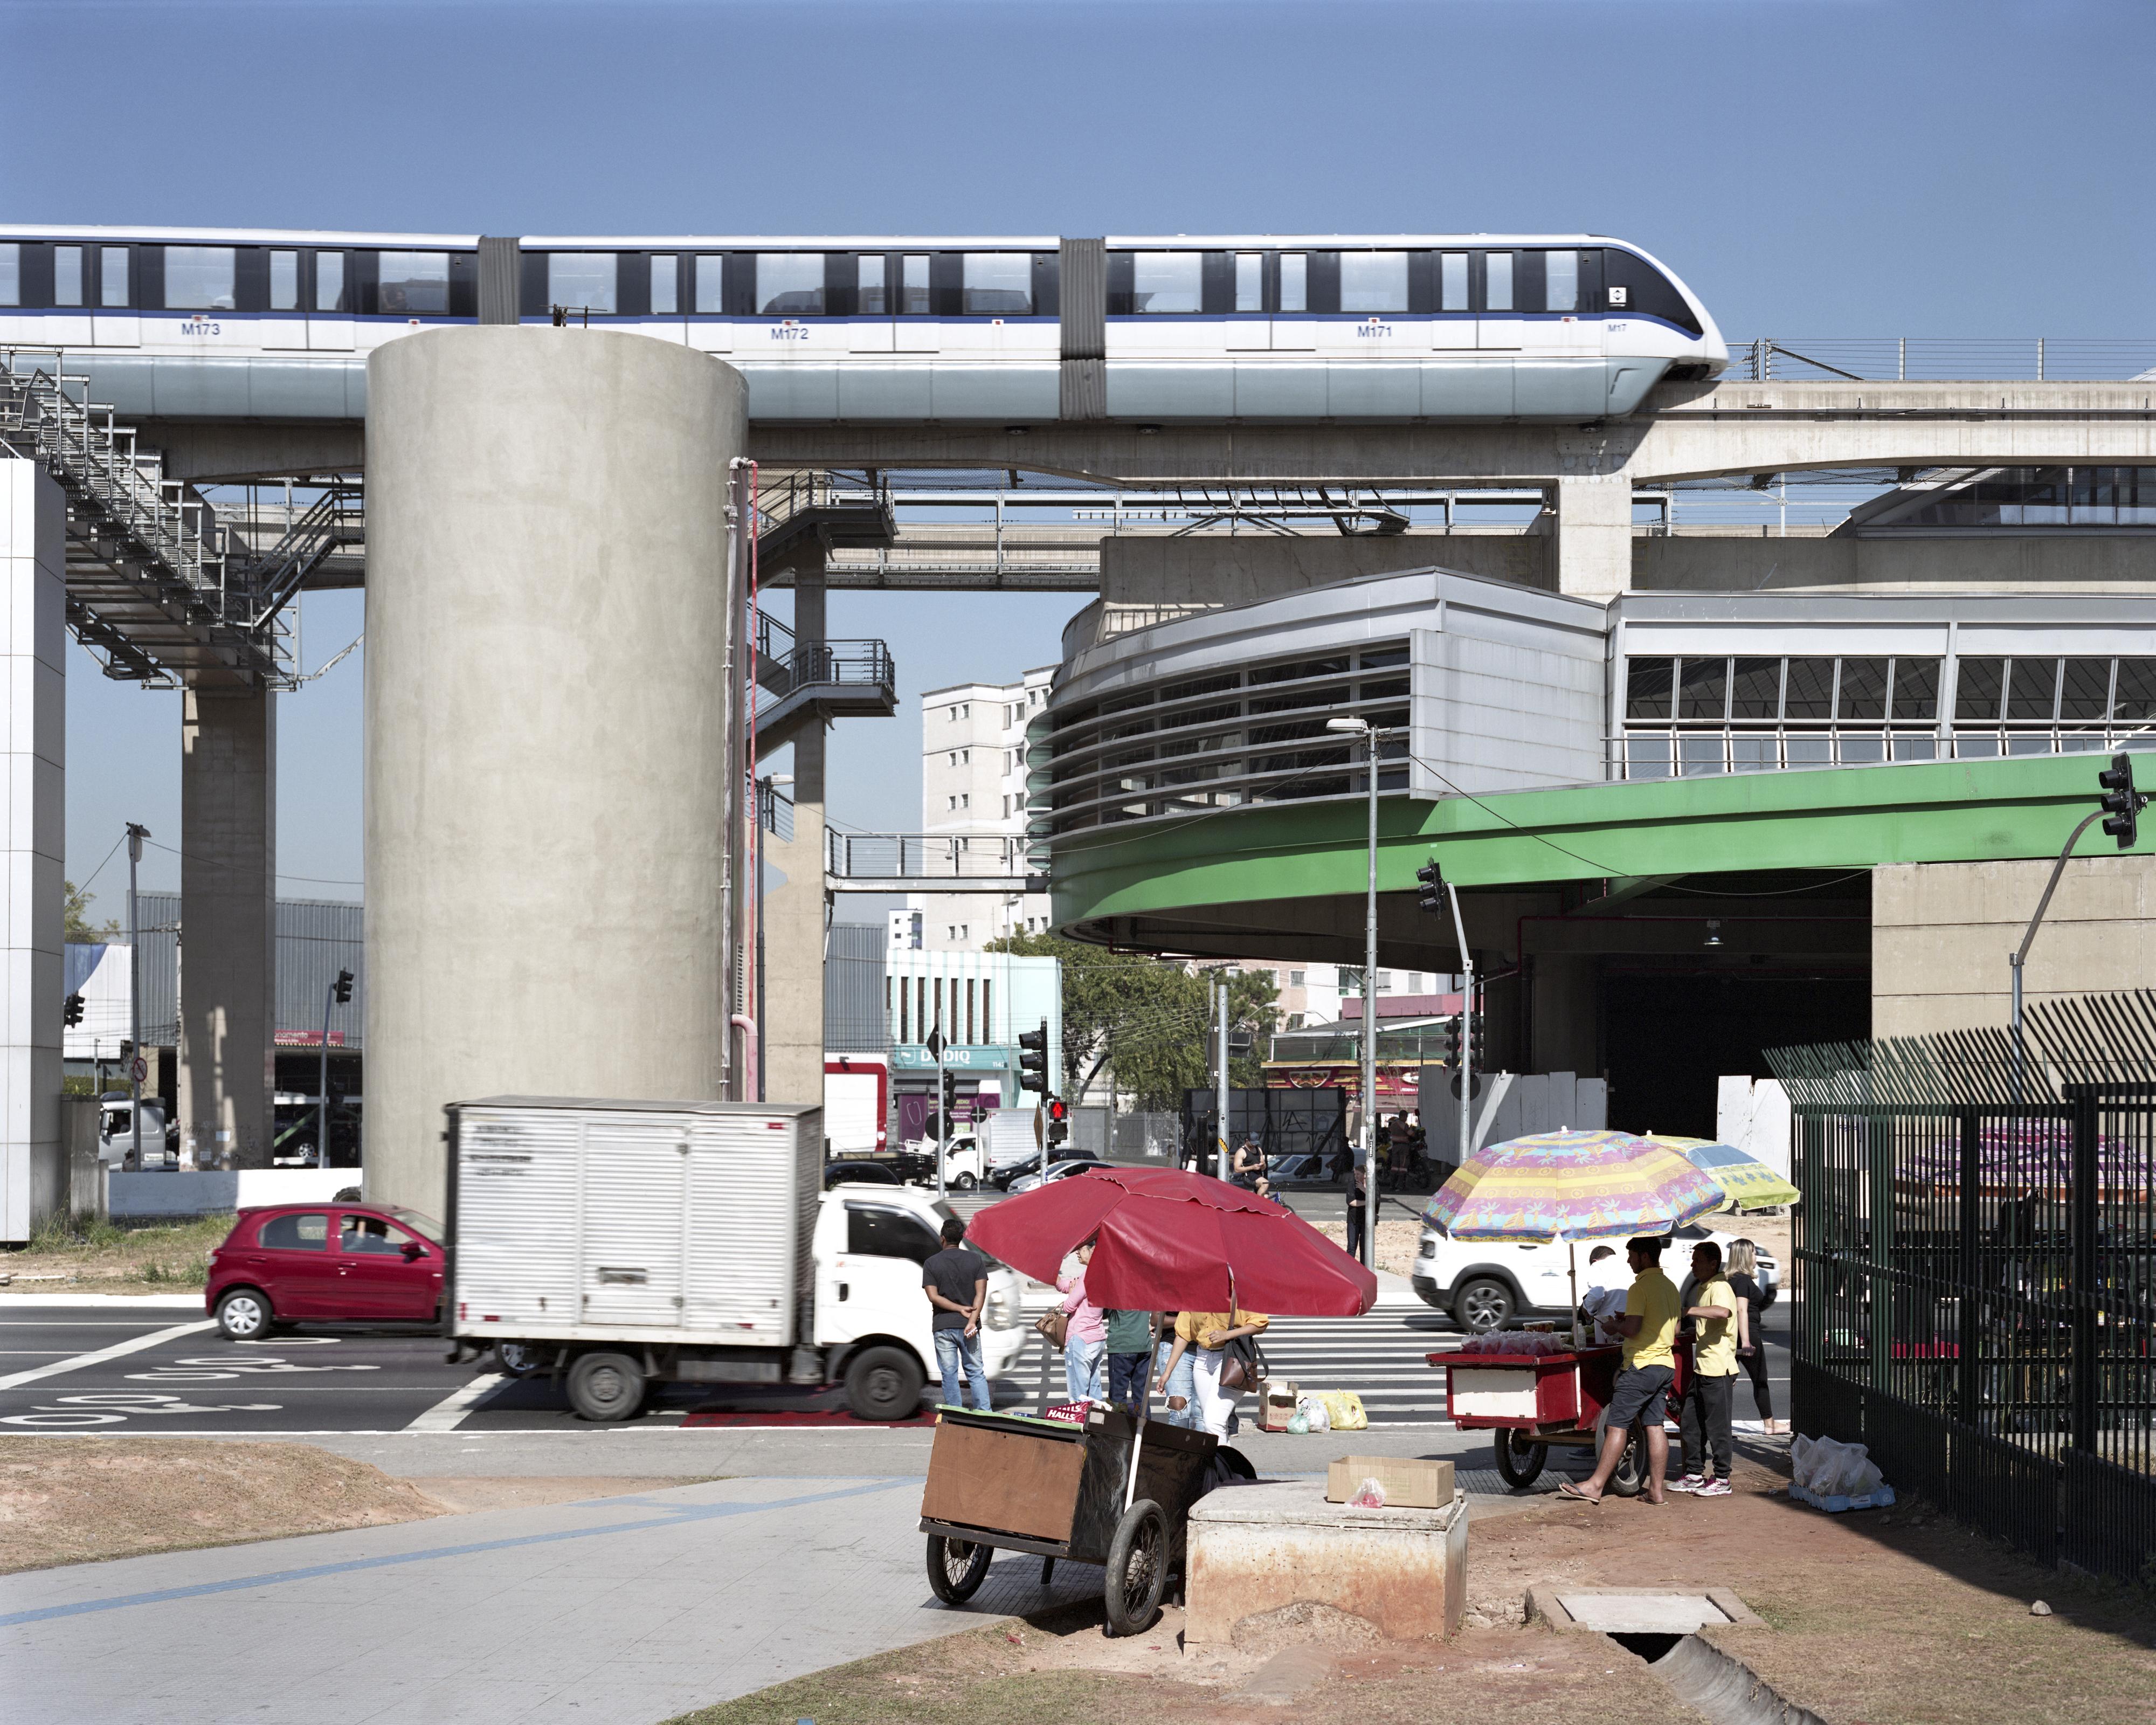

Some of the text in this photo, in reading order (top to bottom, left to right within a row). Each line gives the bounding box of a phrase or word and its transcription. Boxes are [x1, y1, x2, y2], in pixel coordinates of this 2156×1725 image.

[182, 323, 220, 335] M173
[771, 328, 809, 340] M172
[1357, 326, 1392, 337] M171
[921, 1050, 971, 1064] DDIQ
[1047, 1409, 1076, 1420] HALLS
